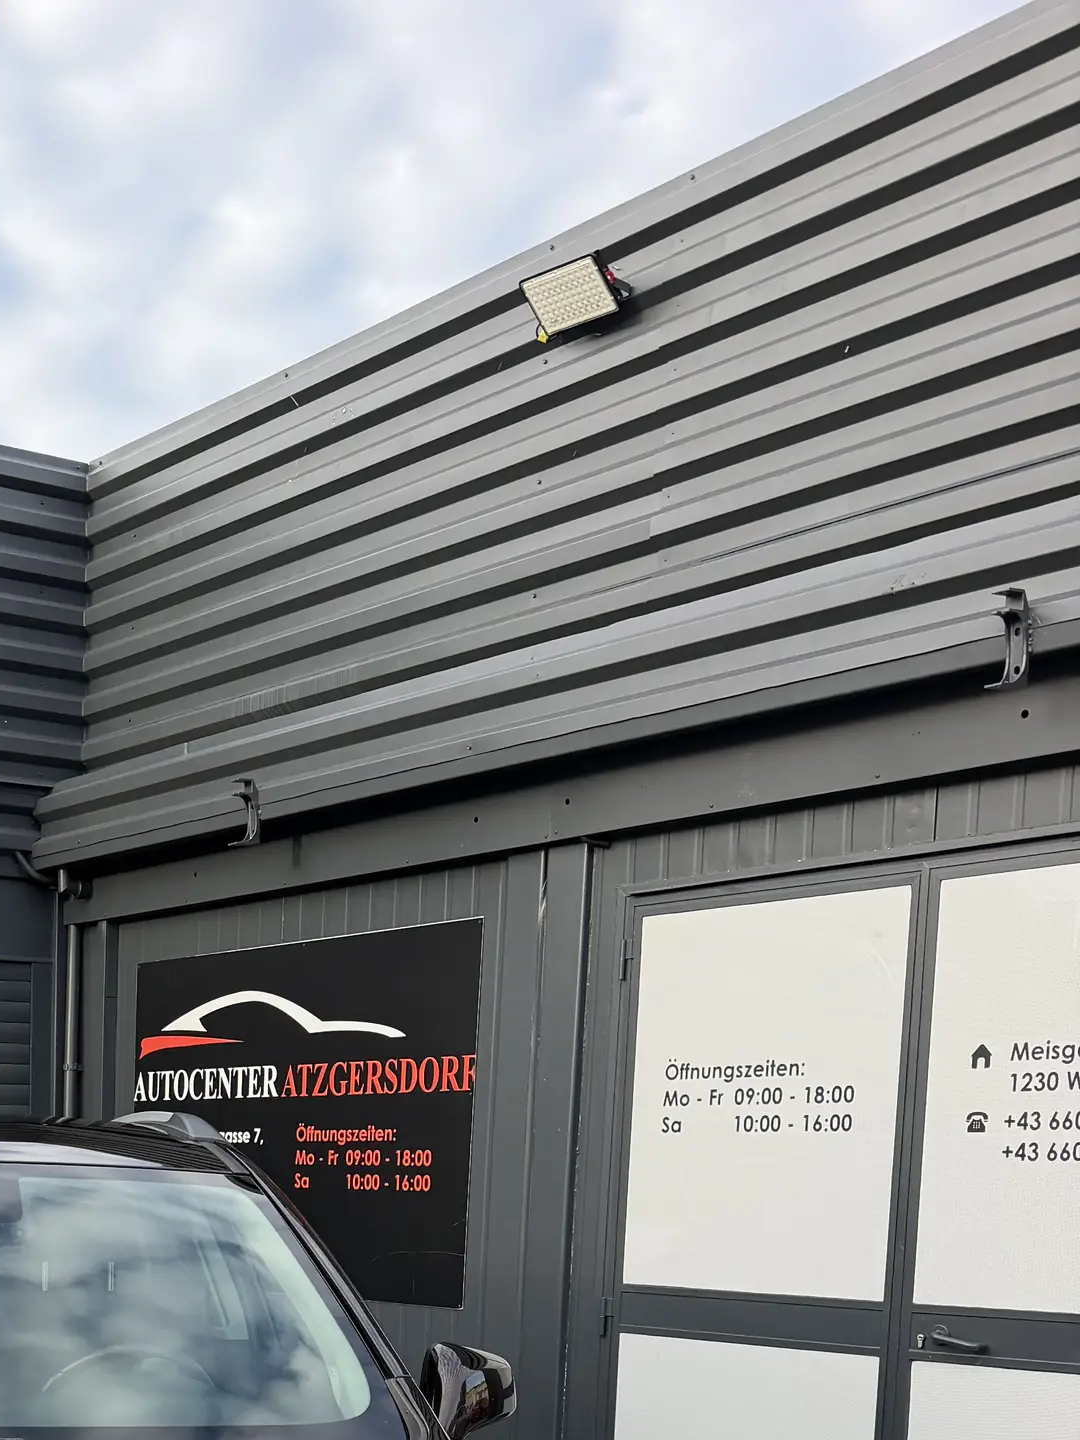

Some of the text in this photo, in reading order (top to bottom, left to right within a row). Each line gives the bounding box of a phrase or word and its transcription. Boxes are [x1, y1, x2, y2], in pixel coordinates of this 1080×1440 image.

[1011, 1040, 1080, 1065] Meisg
[133, 1054, 476, 1102] AUTOCENTER ATZGERSDORF
[666, 1059, 806, 1083] Öffnungszeiten:
[1011, 1071, 1059, 1092] 1230
[663, 1090, 690, 1107] Mo
[709, 1089, 724, 1106] Fr
[734, 1087, 783, 1106] 09:00
[804, 1085, 855, 1104] 18:00
[661, 1116, 682, 1134] Sa
[734, 1114, 781, 1133] 10:00
[803, 1113, 853, 1132] 16:00
[1004, 1111, 1041, 1131] +43
[253, 1127, 264, 1146] 7,
[295, 1123, 397, 1146] Öffnungszeiten:
[294, 1149, 315, 1166] Mo
[327, 1150, 339, 1166] Fr
[345, 1150, 381, 1167] 09:00
[395, 1150, 432, 1167] 18:00
[1002, 1142, 1039, 1161] +43
[293, 1173, 310, 1189] Sa
[346, 1173, 381, 1190] 10:00
[394, 1174, 431, 1192] 16:00
